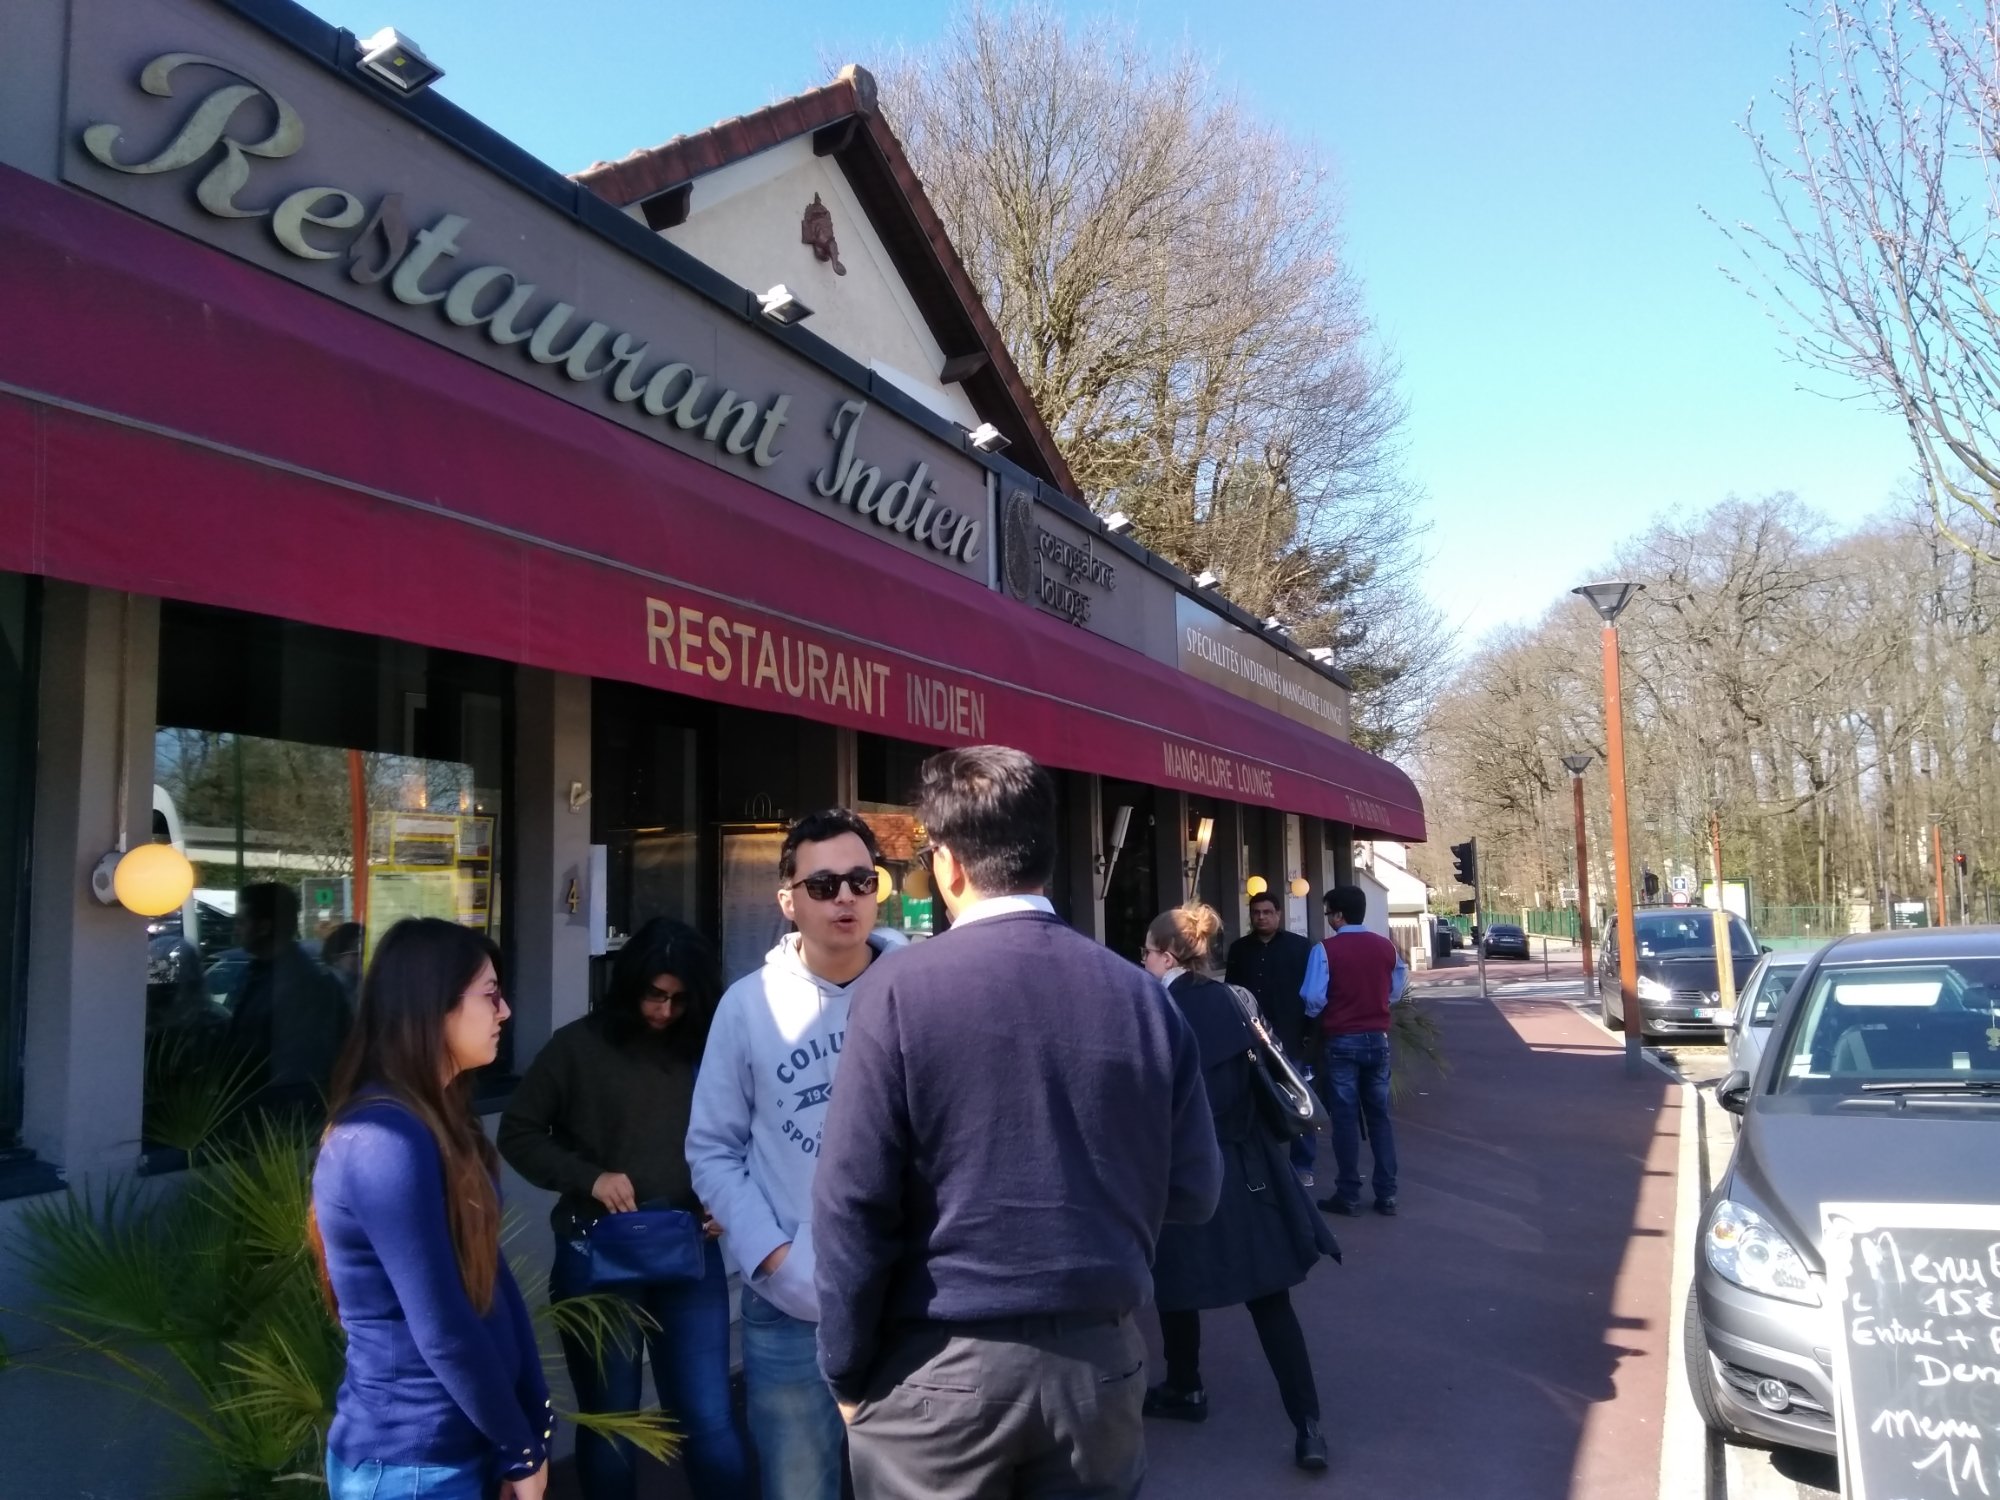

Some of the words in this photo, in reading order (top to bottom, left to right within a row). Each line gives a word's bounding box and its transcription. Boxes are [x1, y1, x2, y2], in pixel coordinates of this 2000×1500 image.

[83, 52, 792, 467] Restaurant
[814, 399, 982, 564] Indien
[646, 597, 890, 717] RESTAURANT
[906, 672, 985, 740] INDIEN
[1240, 654, 1282, 695] INDIENNES
[1282, 679, 1319, 714] MANGALORE
[1320, 699, 1342, 726] LOUNGE
[1163, 741, 1233, 790] MANGALORE
[1235, 762, 1275, 798] LOUNGE
[567, 878, 581, 914] 4
[806, 1089, 821, 1103] 19
[1861, 1232, 1987, 1288] Menu
